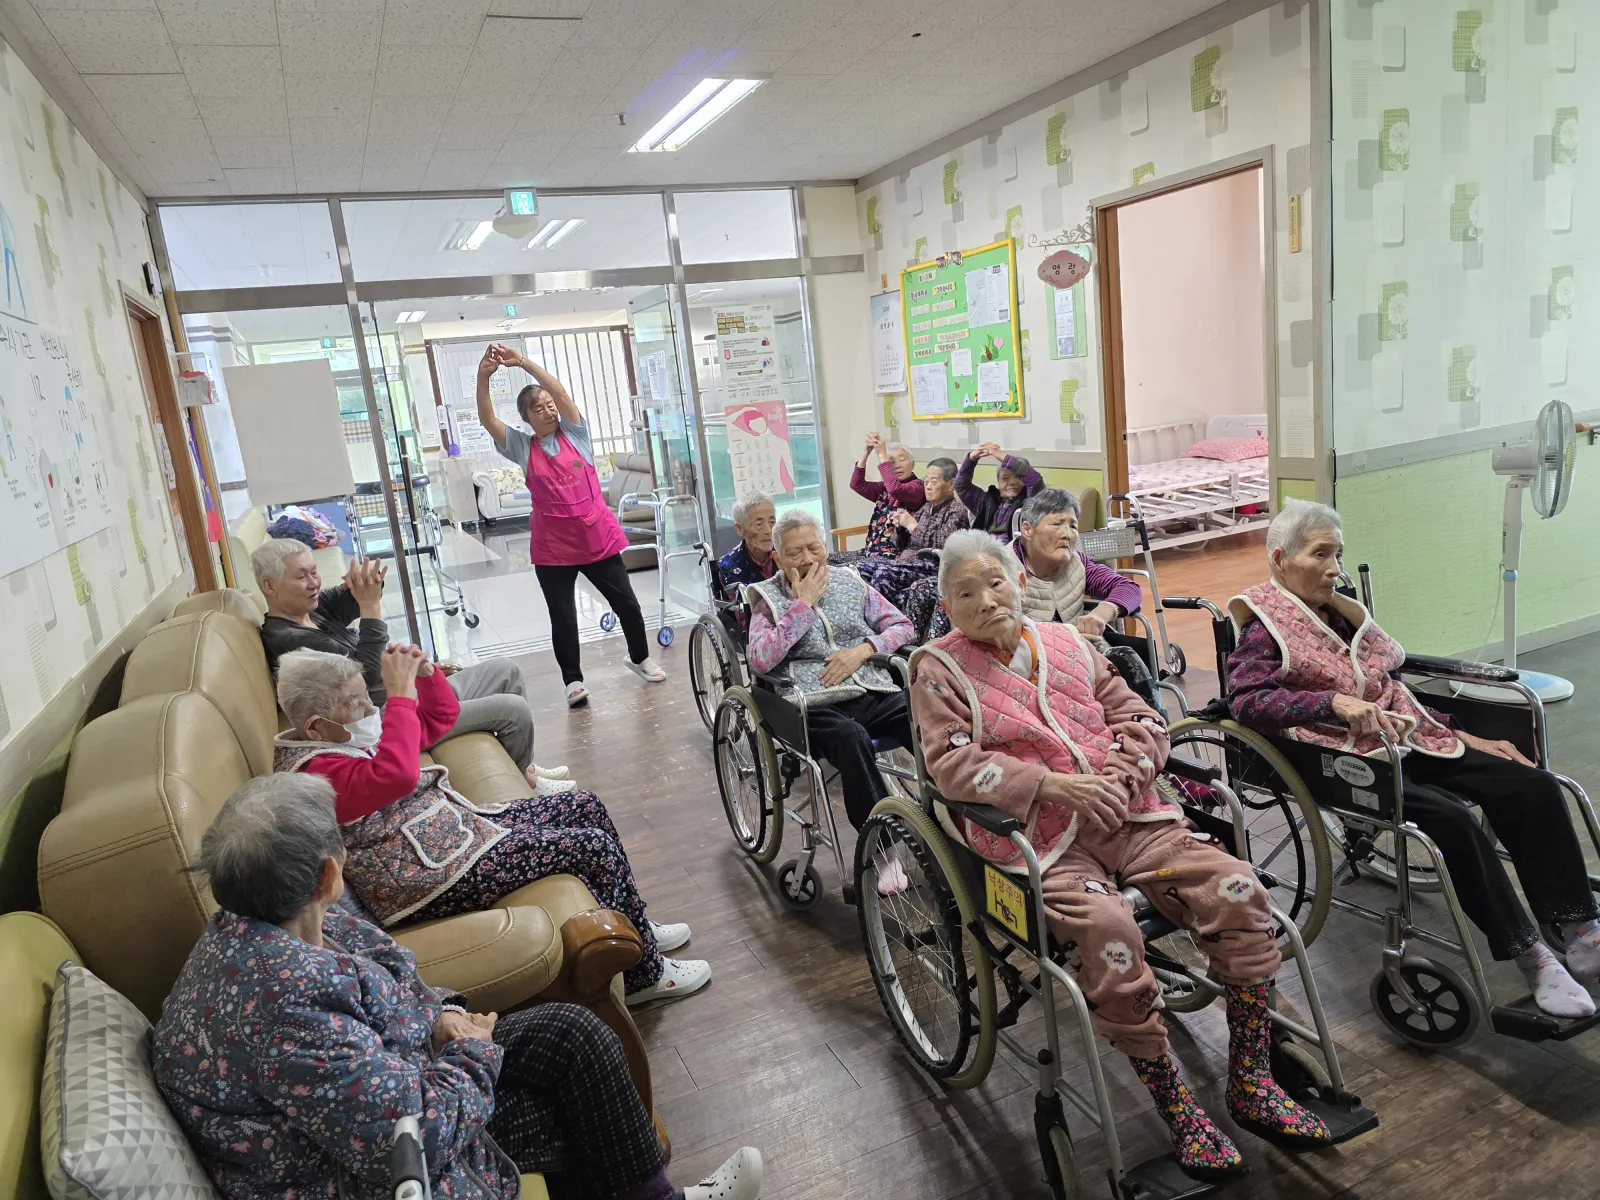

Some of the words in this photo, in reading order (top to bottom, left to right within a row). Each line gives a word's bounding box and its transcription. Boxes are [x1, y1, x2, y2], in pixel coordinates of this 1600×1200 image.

[1052, 263, 1061, 275] 영
[1067, 262, 1077, 275] 광
[988, 870, 1023, 908] 낙상주의
